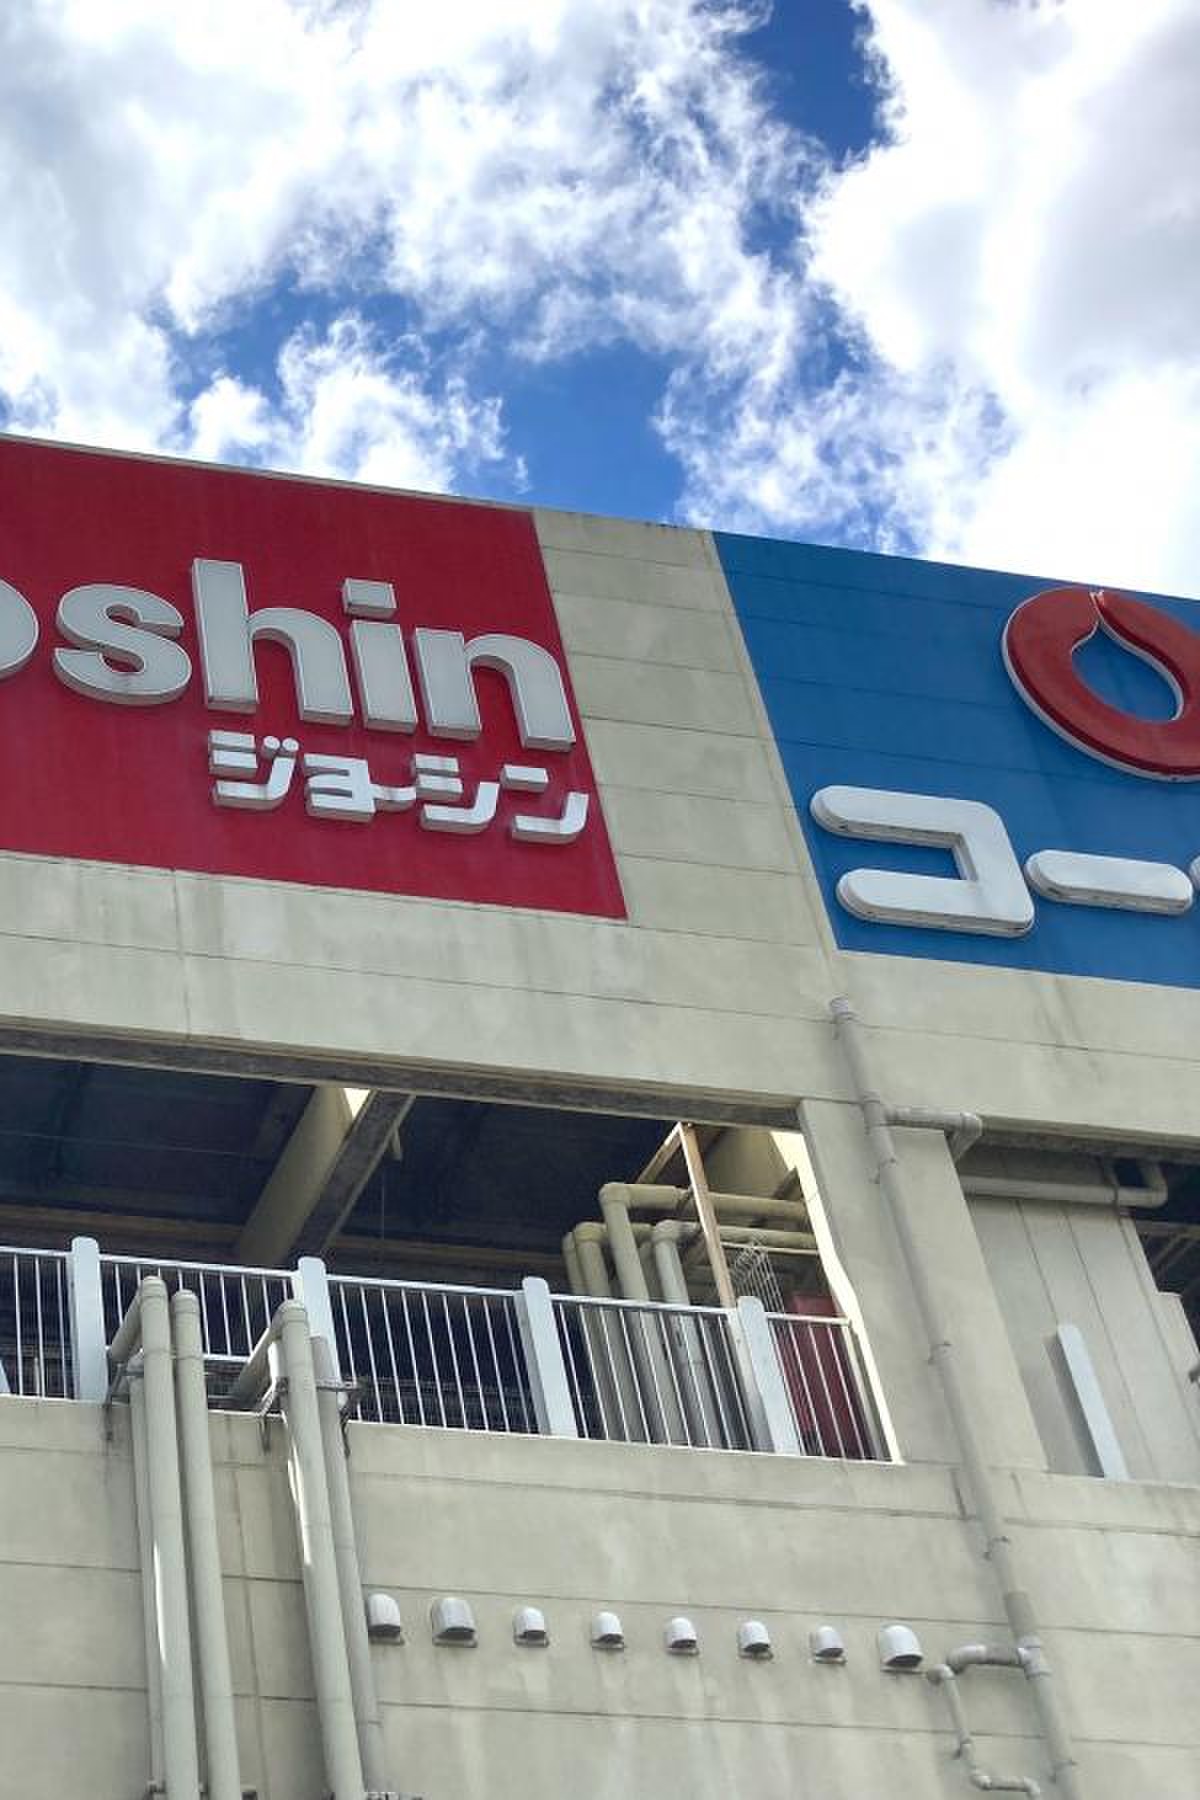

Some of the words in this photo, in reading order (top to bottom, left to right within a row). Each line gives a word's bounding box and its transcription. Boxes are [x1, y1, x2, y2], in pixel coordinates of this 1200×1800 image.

[208, 729, 588, 845] ジョーシン
[810, 785, 1200, 939] コー
